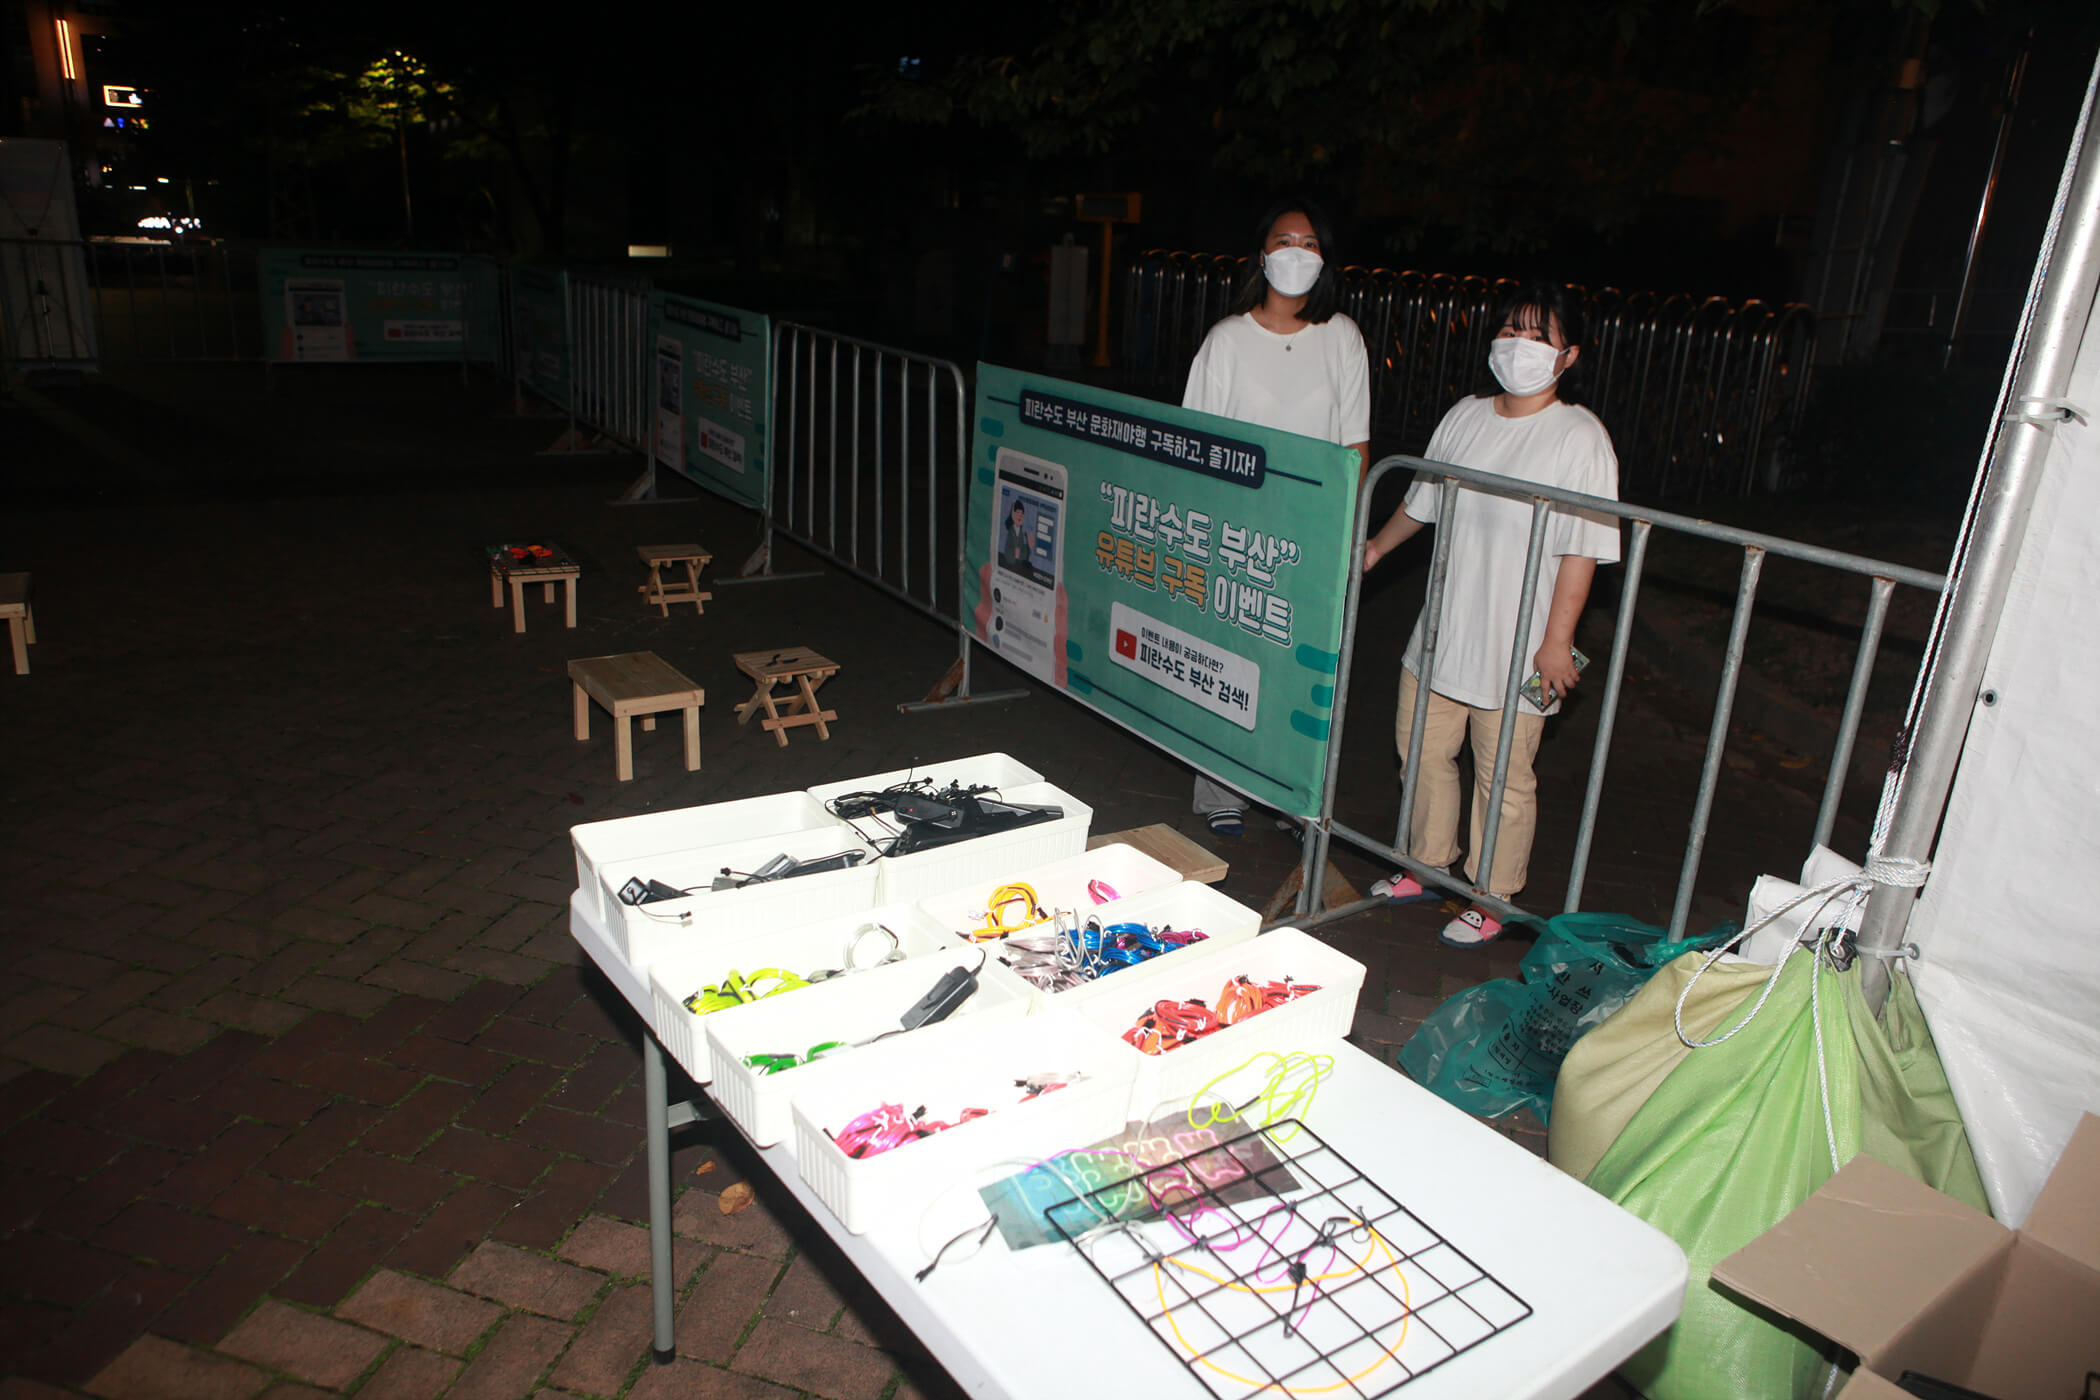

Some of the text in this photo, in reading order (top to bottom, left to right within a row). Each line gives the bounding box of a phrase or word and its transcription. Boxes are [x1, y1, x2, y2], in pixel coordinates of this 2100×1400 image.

[1025, 398, 1257, 477] 피란수도 부산 문화재야행 구독하고, 즐기자!
[1099, 480, 1213, 564] “피란수도
[1217, 520, 1300, 588] 부산”
[1096, 530, 1157, 591] 유튜브
[1161, 555, 1209, 614] 구독
[1213, 574, 1292, 647] 이벤트
[1140, 642, 1250, 712] 피란수도 부산 검색!
[1141, 626, 1161, 646] 이벤트
[1183, 645, 1225, 674] 궁금하다면?
